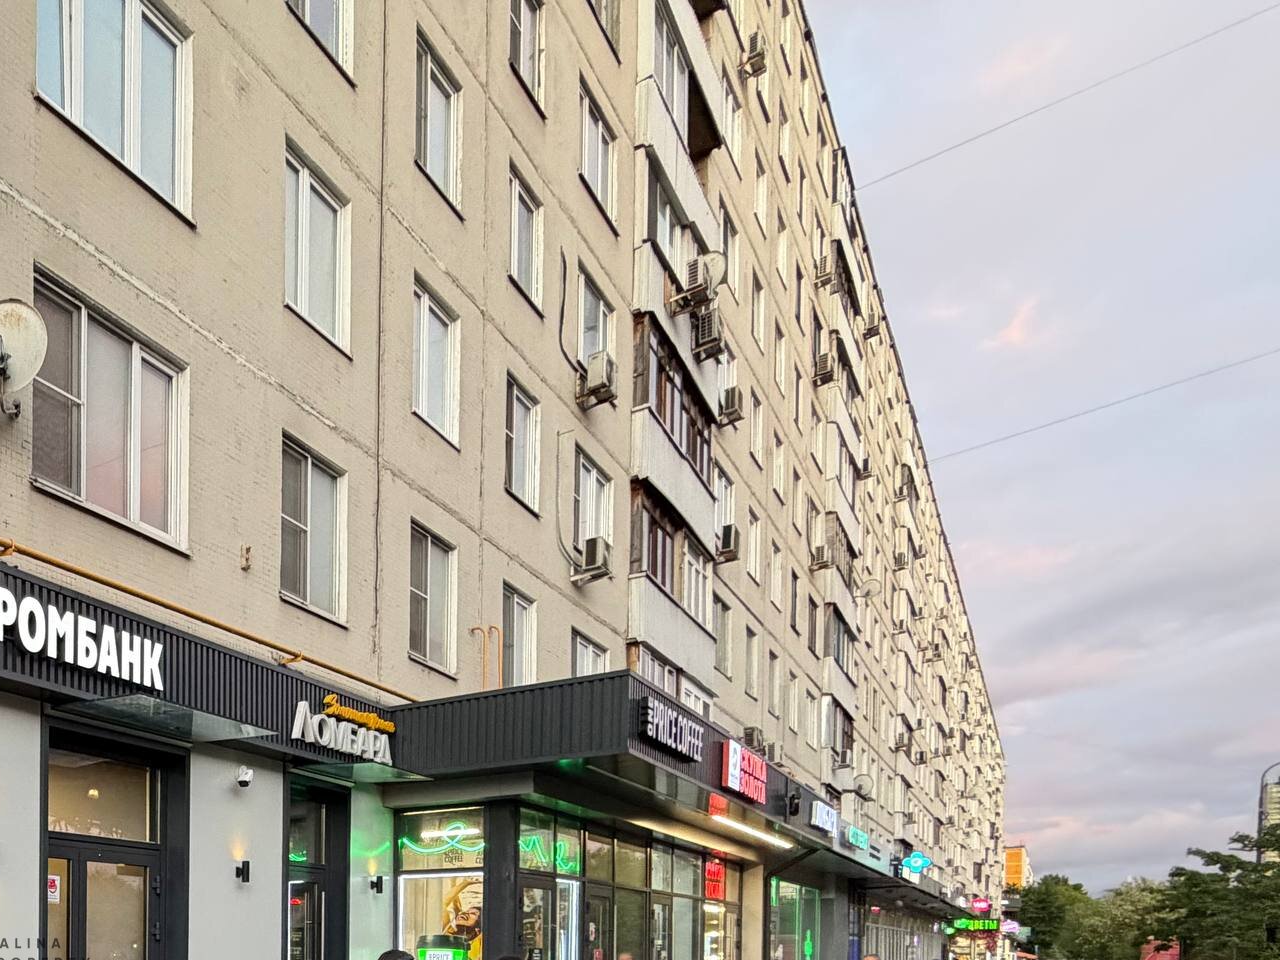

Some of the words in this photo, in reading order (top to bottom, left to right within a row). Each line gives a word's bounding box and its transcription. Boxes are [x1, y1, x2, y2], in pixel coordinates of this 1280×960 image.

[291, 700, 393, 766] ЛОМБАРД
[653, 699, 677, 750] PRICE
[677, 713, 704, 762] COFFEE
[969, 920, 997, 931] ЦВЕТЫ
